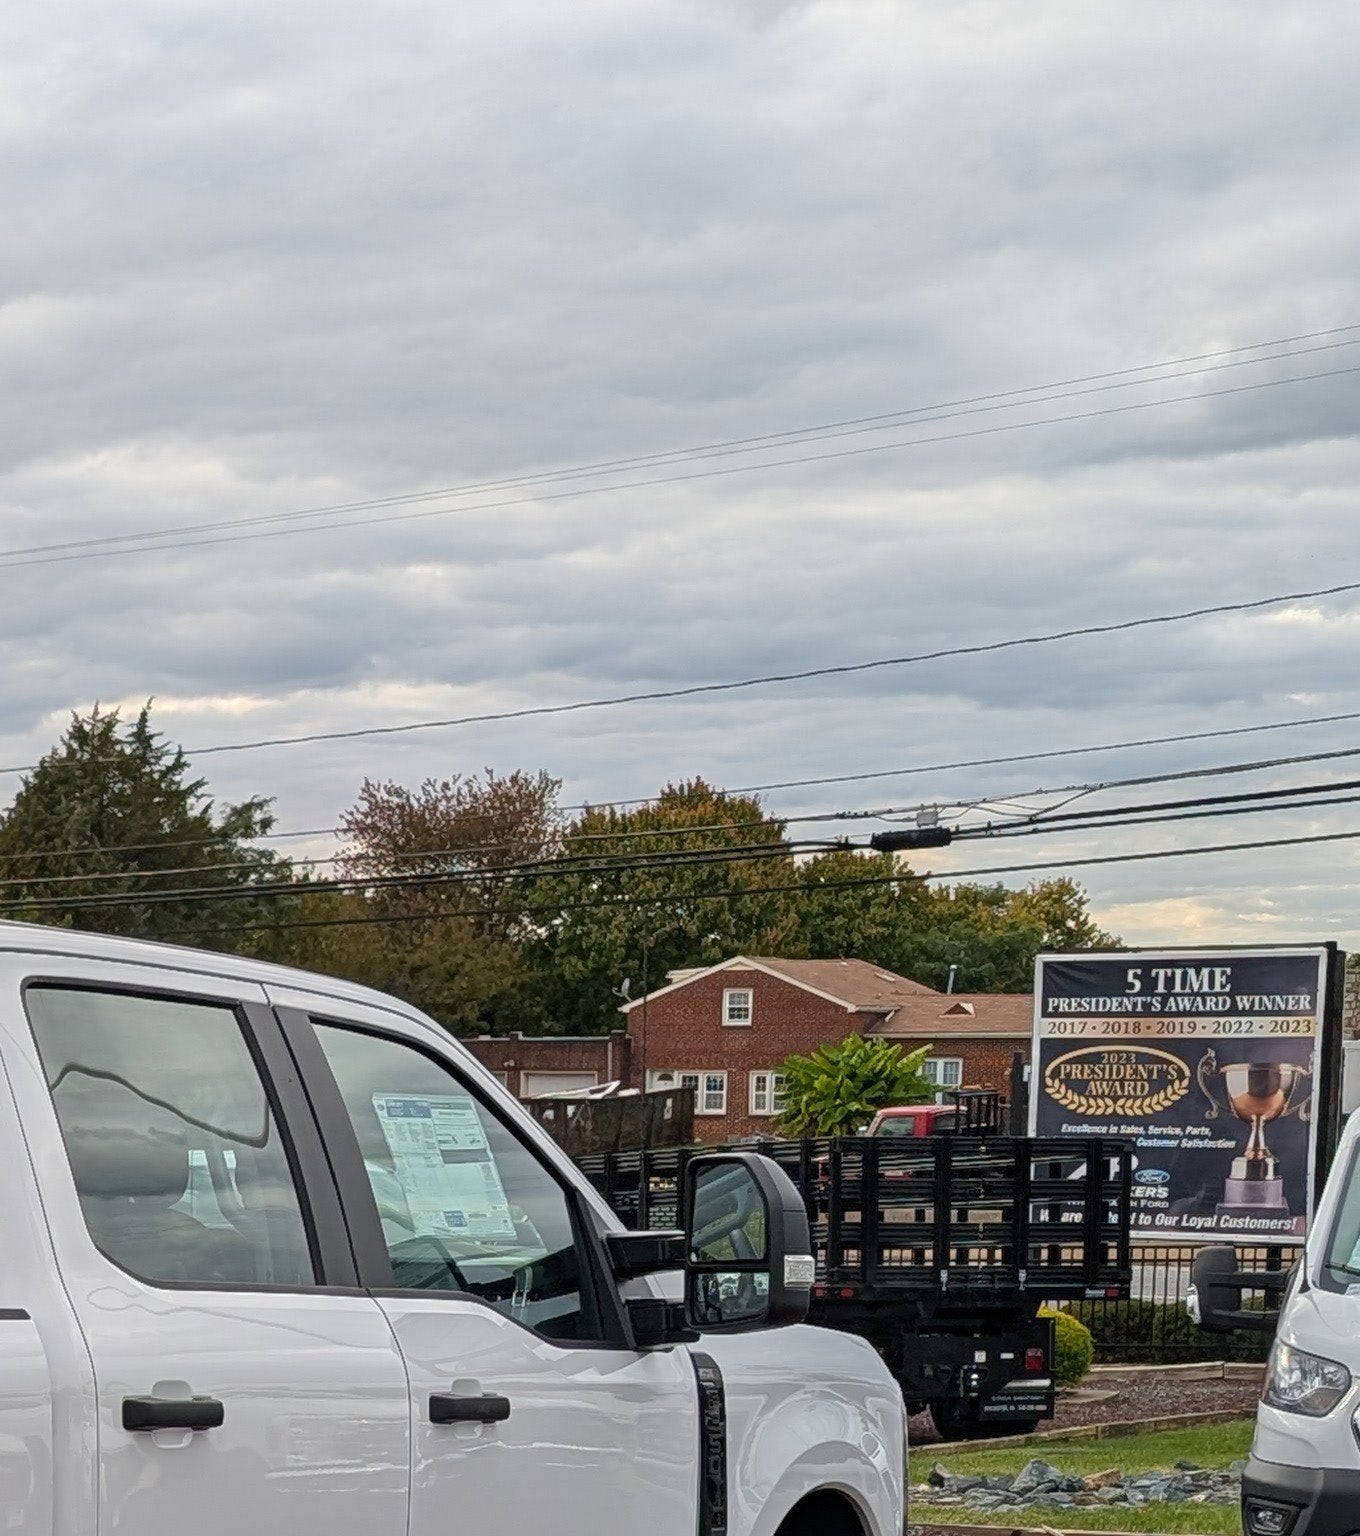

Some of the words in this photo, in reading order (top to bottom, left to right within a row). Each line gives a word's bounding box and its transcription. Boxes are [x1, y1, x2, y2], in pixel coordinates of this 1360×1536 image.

[1125, 968, 1142, 993] 5
[1151, 966, 1231, 993] TIME
[1047, 997, 1161, 1012] PRESIDENT'S
[1164, 995, 1231, 1012] AWARD
[1234, 994, 1312, 1011] WINNER
[1047, 1021, 1088, 1035] 2017
[1101, 1020, 1142, 1035] 2018
[1156, 1020, 1197, 1035] 2019
[1212, 1020, 1254, 1034] 2022
[1268, 1019, 1312, 1034] 2023
[1100, 1053, 1136, 1063] 2023
[1059, 1063, 1178, 1080] PRESIDENT'S
[1084, 1080, 1150, 1096] AWARD
[1138, 1213, 1152, 1226] to
[1154, 1213, 1179, 1227] Our
[1181, 1213, 1216, 1231] Loyal
[1219, 1214, 1297, 1231] Customers!
